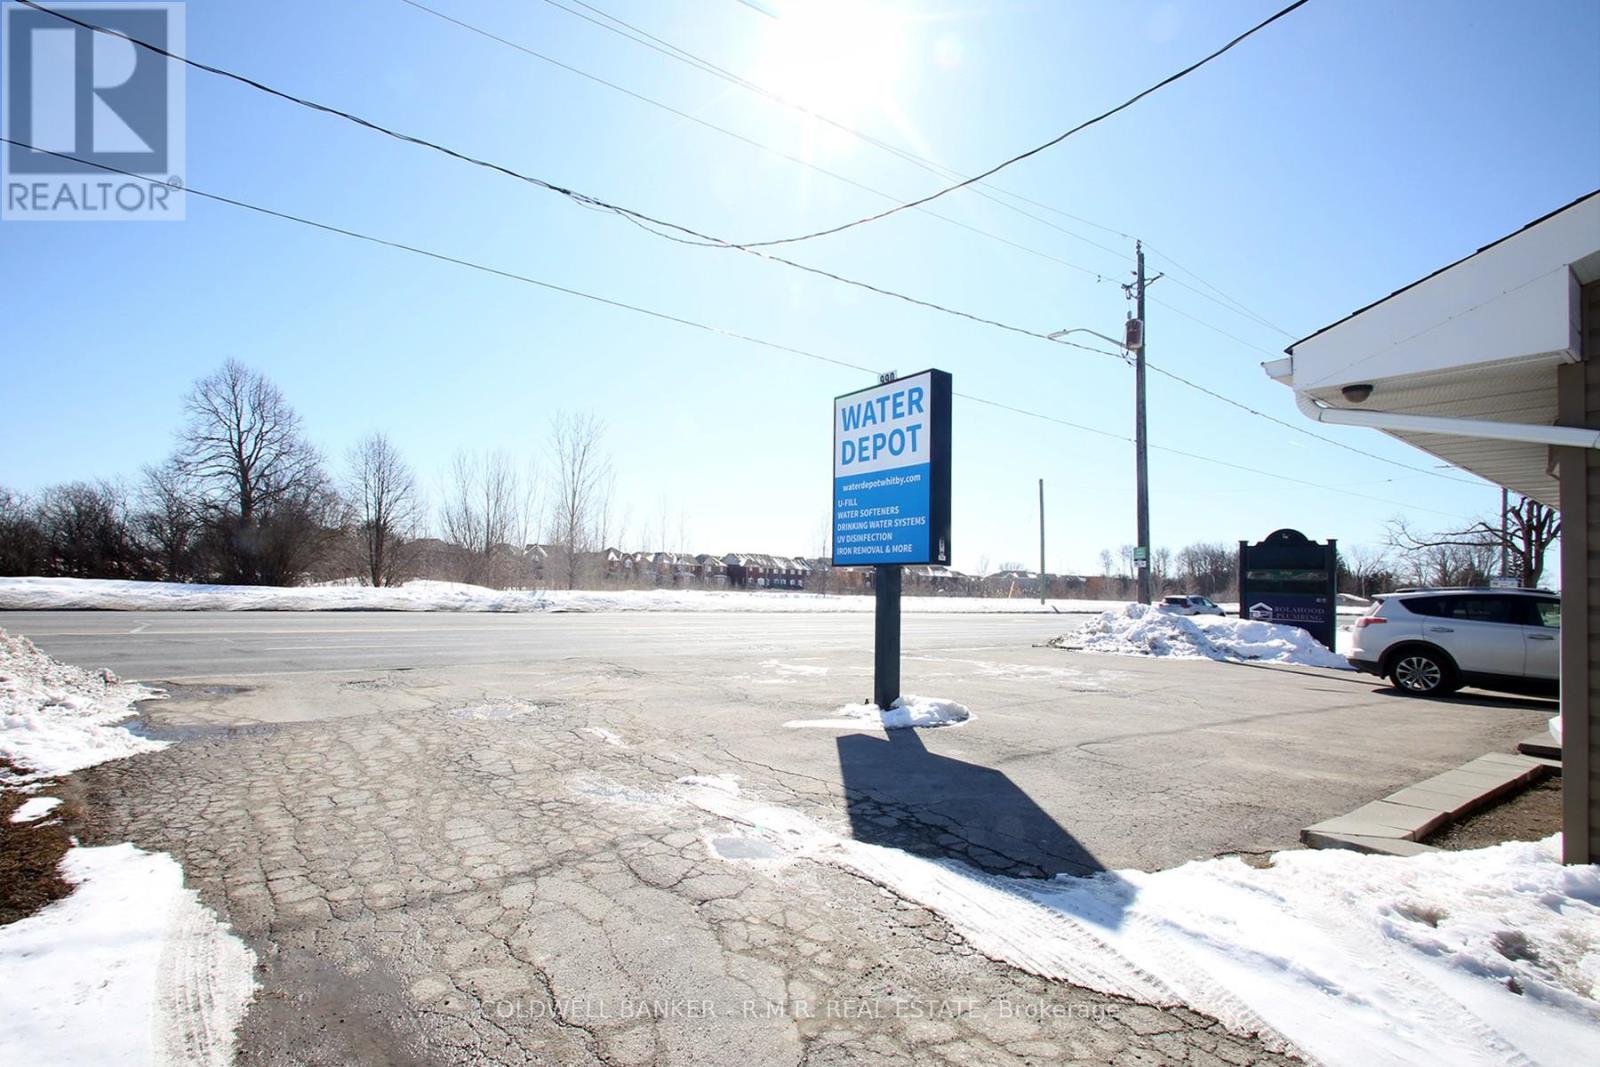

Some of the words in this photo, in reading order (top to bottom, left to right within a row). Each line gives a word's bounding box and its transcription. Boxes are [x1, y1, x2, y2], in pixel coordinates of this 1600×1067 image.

[841, 386, 924, 431] WATER
[841, 424, 922, 465] DEPOT
[842, 473, 921, 492] waterdepotwhitby.com
[837, 497, 858, 508] U-FILL
[837, 510, 859, 520] WATER
[859, 506, 900, 517] SOFTENERS
[837, 521, 868, 531] DRINKING
[869, 519, 893, 529] WATER
[894, 516, 926, 526] SYSTEMS
[837, 535, 846, 544] UV
[846, 532, 893, 543] DISINFECTION
[837, 547, 852, 556] IRON
[853, 545, 884, 555] REMOVAL
[892, 544, 913, 553] MORE
